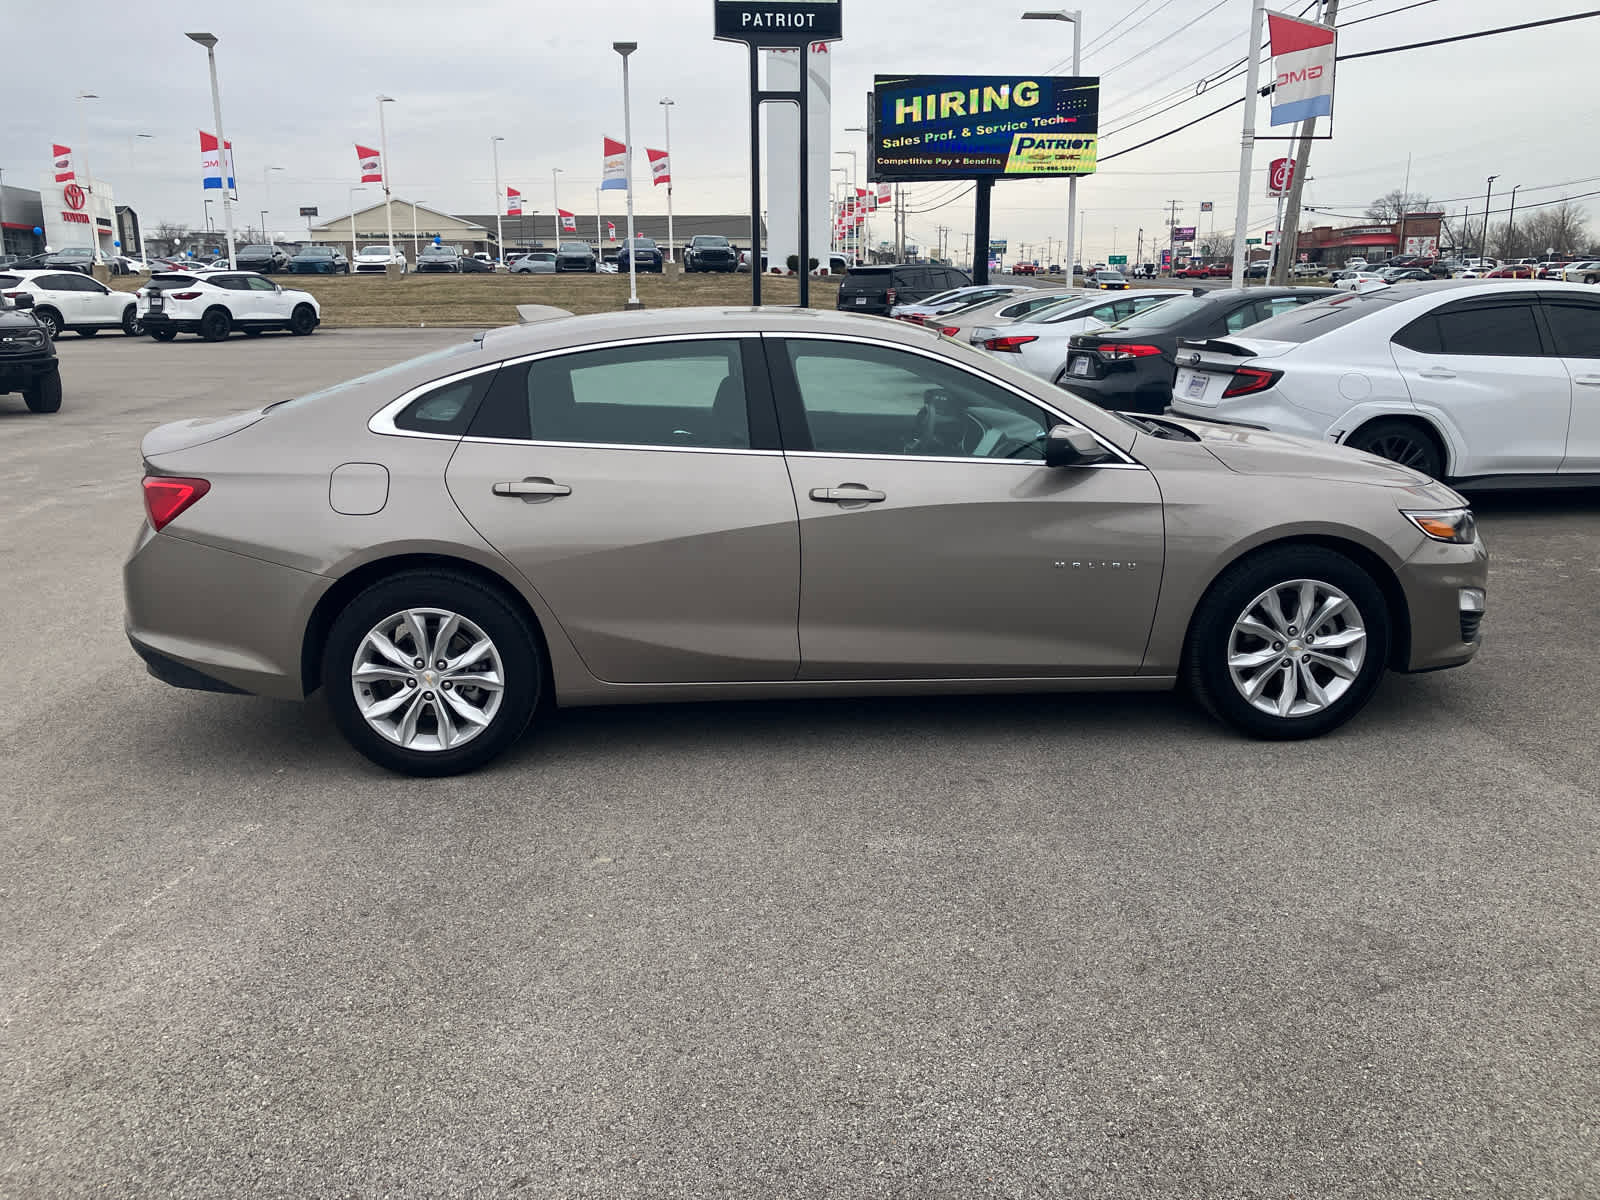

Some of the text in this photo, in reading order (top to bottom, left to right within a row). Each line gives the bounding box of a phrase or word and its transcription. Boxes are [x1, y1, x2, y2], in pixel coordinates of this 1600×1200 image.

[742, 13, 815, 27] PATRIOT
[895, 80, 1040, 125] HIRING
[882, 114, 1068, 149] Sales Prof. & Service Tech.
[1015, 136, 1094, 155] PATRIOT
[877, 157, 933, 166] Competitive
[935, 157, 952, 167] Pay
[962, 157, 1001, 165] Benefits
[61, 211, 90, 224] TOYOTA
